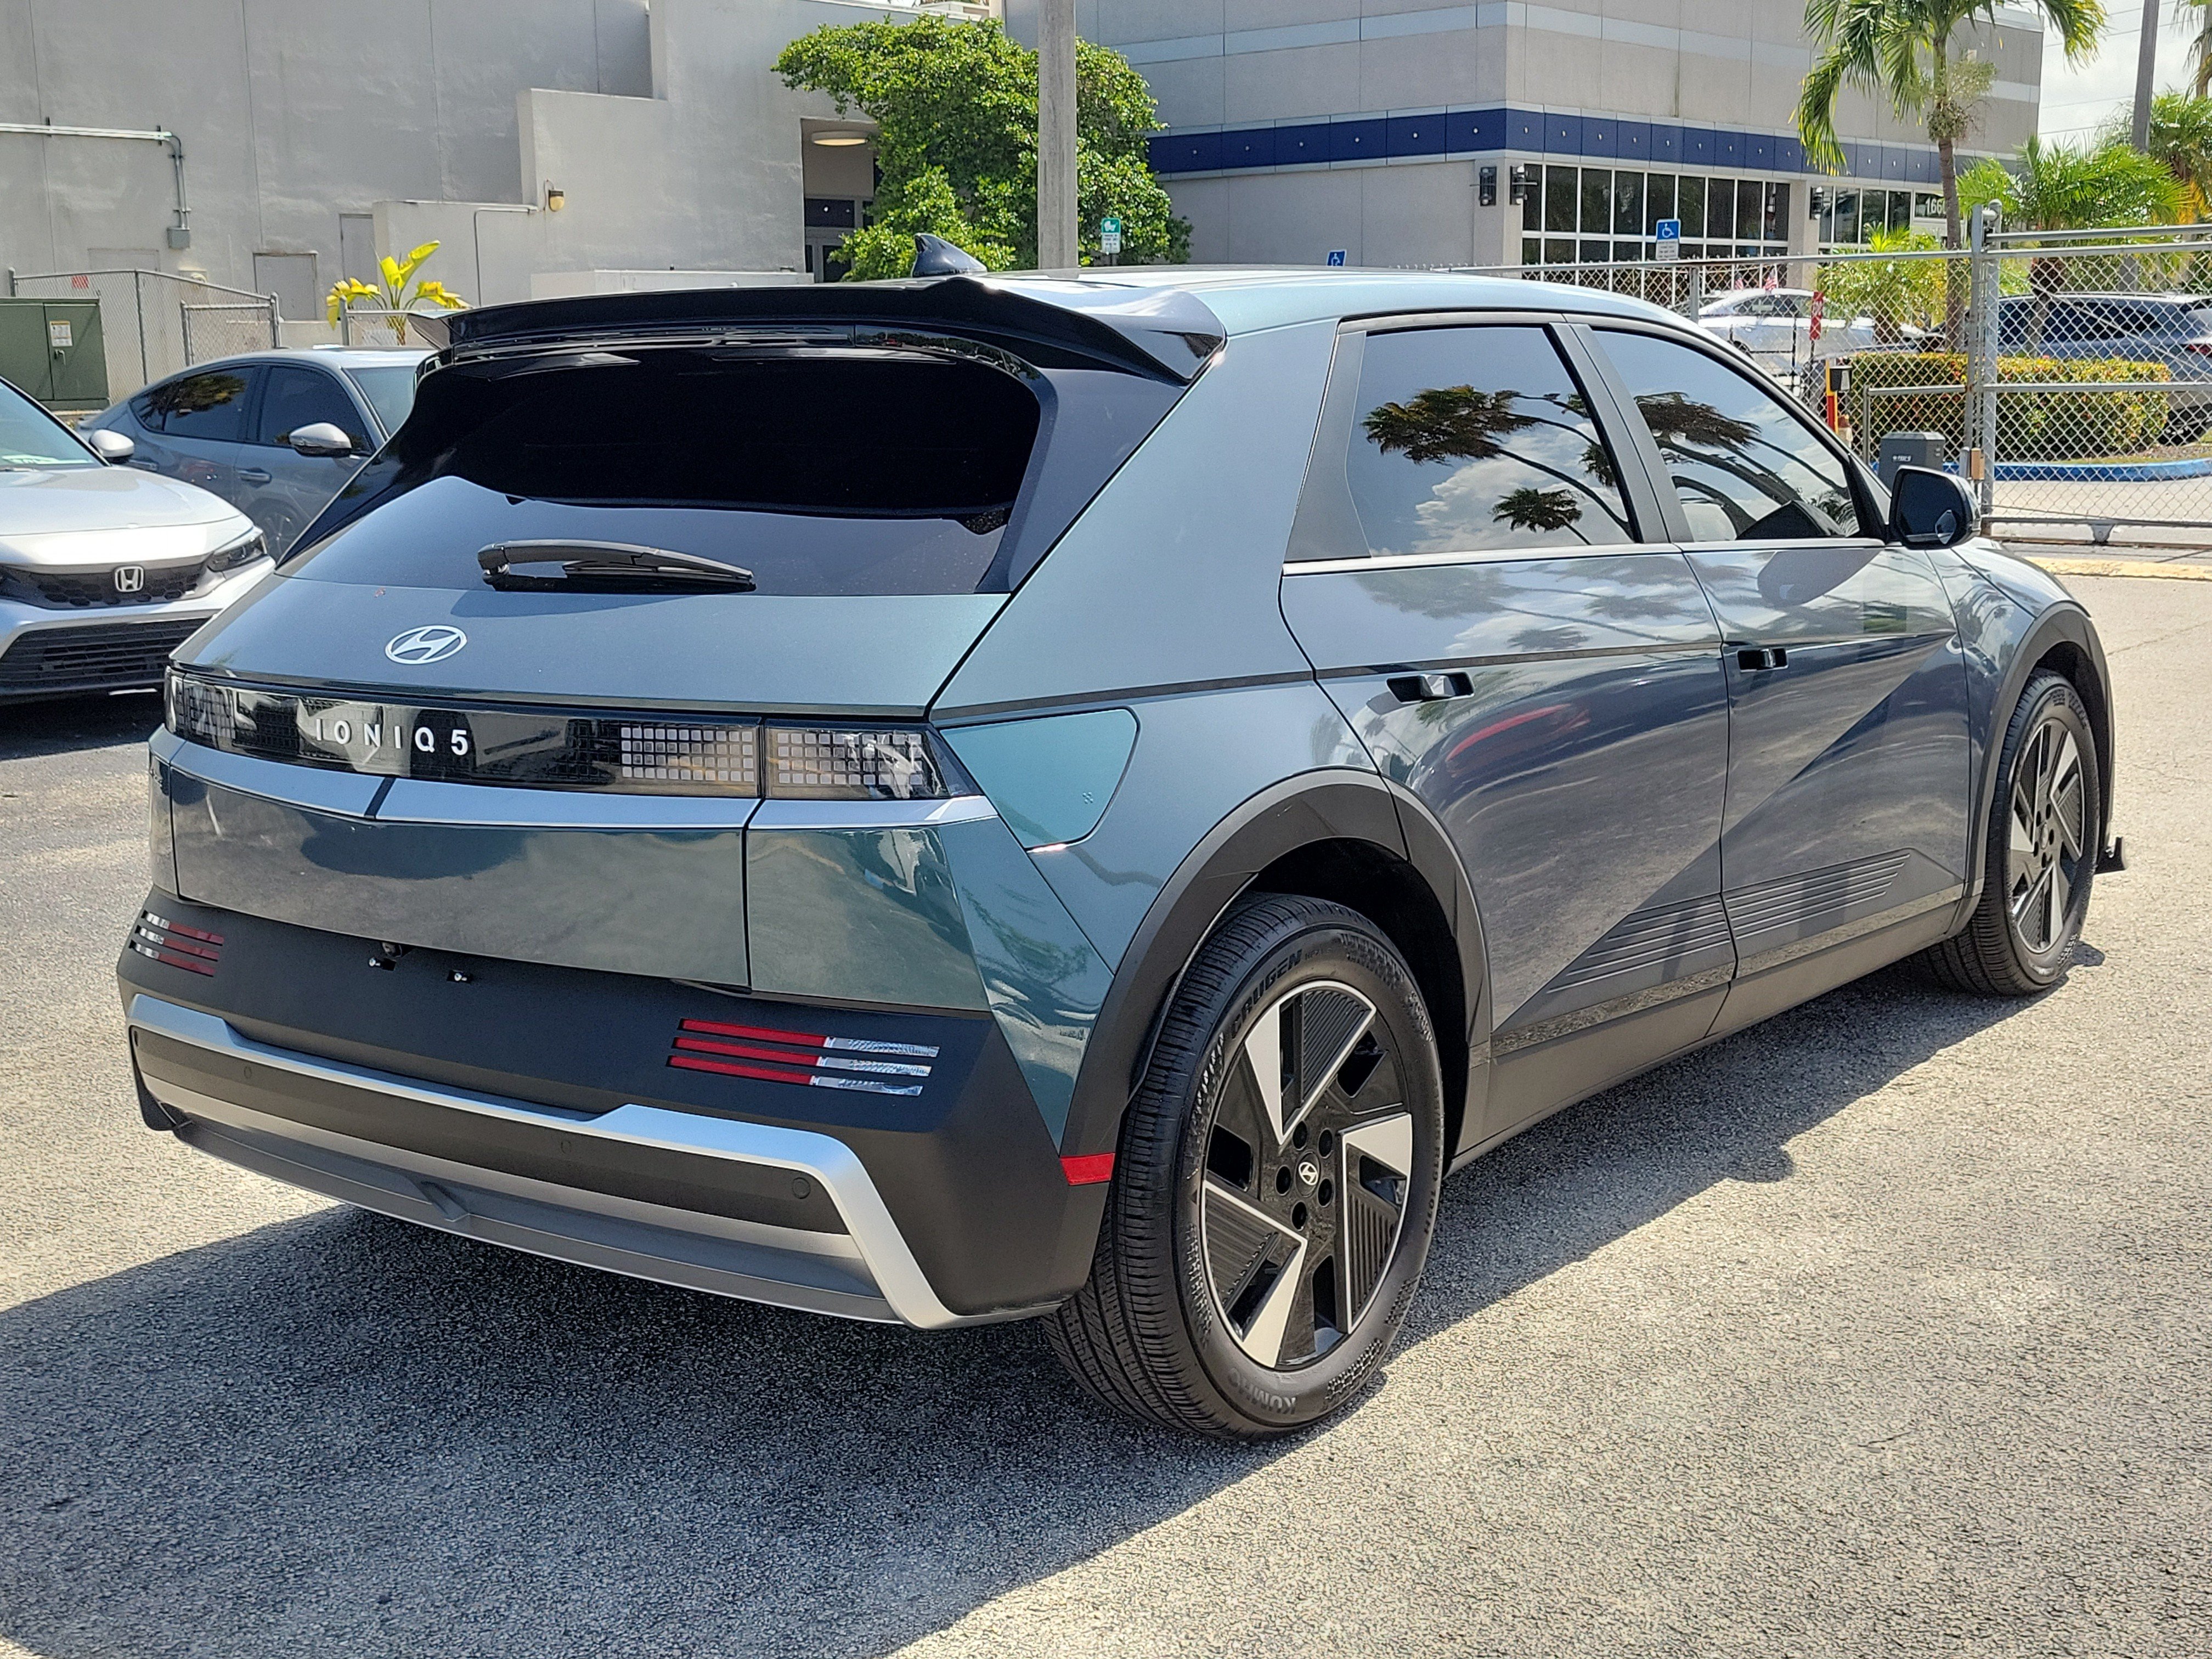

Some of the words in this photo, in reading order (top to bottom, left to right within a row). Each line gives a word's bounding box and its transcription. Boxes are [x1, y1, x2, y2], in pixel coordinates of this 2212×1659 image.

[316, 718, 435, 753] IONIQ
[450, 729, 469, 756] 5
[1231, 949, 1303, 1040] CRUGEN
[1227, 1367, 1298, 1415] KUMHO
